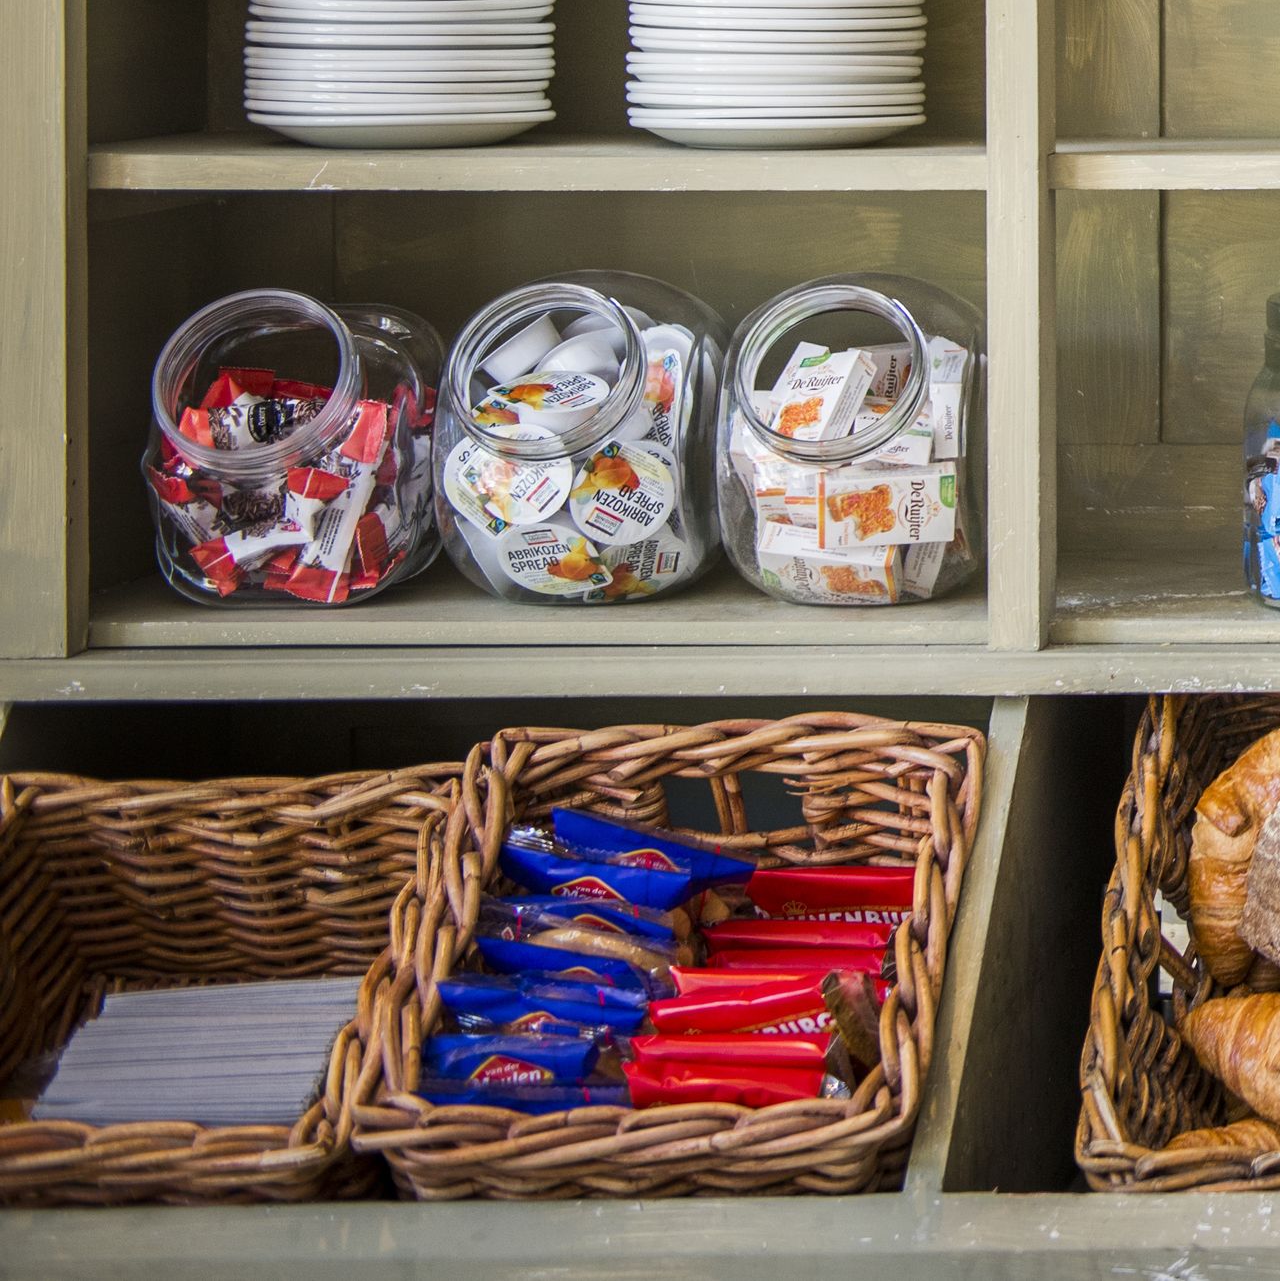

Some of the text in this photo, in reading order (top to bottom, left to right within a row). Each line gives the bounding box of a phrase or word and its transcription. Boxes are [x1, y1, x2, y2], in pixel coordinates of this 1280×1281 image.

[791, 373, 844, 391] De Ruijter
[884, 355, 898, 400] Ruijter
[543, 379, 596, 405] ABRIKOZEN
[653, 403, 673, 448] SPREAD
[945, 405, 953, 429] Ruijter
[592, 492, 655, 527] ABRIKOZEN
[618, 484, 665, 515] SPREAD
[910, 480, 925, 541] De Ruijter
[508, 543, 572, 563] ABRIKOZEN
[511, 555, 560, 574] SPREAD
